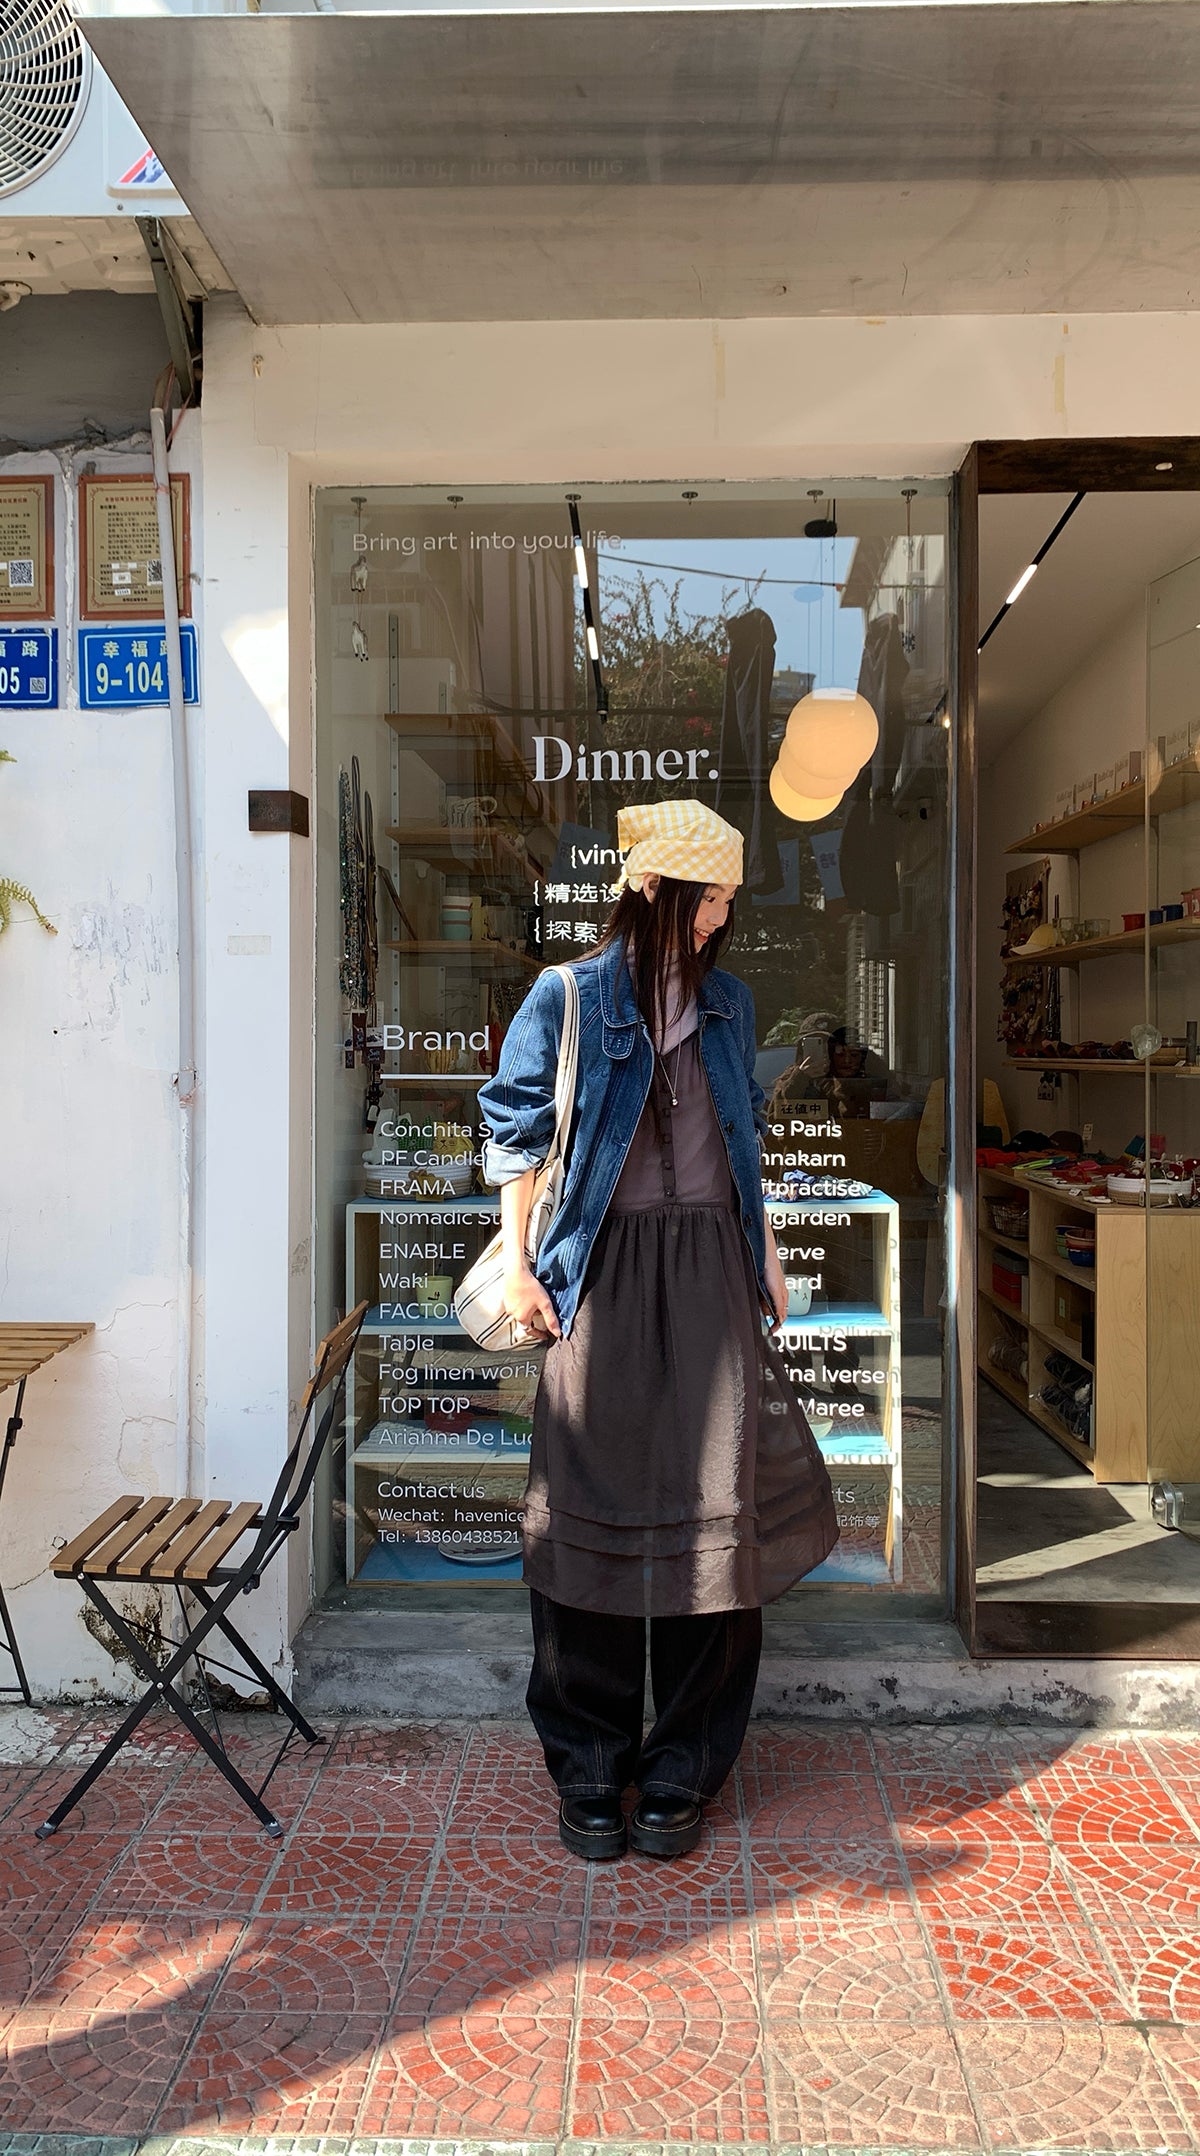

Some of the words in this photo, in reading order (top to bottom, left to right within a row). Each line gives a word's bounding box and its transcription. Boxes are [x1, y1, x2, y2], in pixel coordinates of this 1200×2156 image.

[352, 533, 416, 555] Bring
[423, 533, 458, 551] art
[469, 531, 516, 550] into
[523, 535, 579, 554] your
[96, 661, 164, 694] 9-104
[531, 736, 719, 782] Dinner.
[382, 1025, 490, 1051] Brand
[380, 1121, 472, 1138] Conchita
[790, 1120, 842, 1137] Paris
[381, 1151, 408, 1166] PF
[380, 1180, 456, 1196] FRAMA
[380, 1209, 473, 1225] Nomadic
[380, 1243, 466, 1259] ENABLE
[379, 1272, 428, 1289] Waki
[379, 1335, 434, 1352] Table
[379, 1363, 418, 1385] Fog
[424, 1363, 475, 1381] linen
[481, 1361, 539, 1380] work
[379, 1397, 422, 1414] TOP
[427, 1397, 470, 1414] TOP
[797, 1398, 865, 1417] Maree
[379, 1429, 460, 1446] Arianna
[467, 1429, 494, 1446] De
[377, 1482, 458, 1499] Contact
[462, 1485, 485, 1499] us
[378, 1508, 445, 1523] Wechat:
[378, 1529, 406, 1544] Tel:
[414, 1530, 520, 1544] 13860438521
